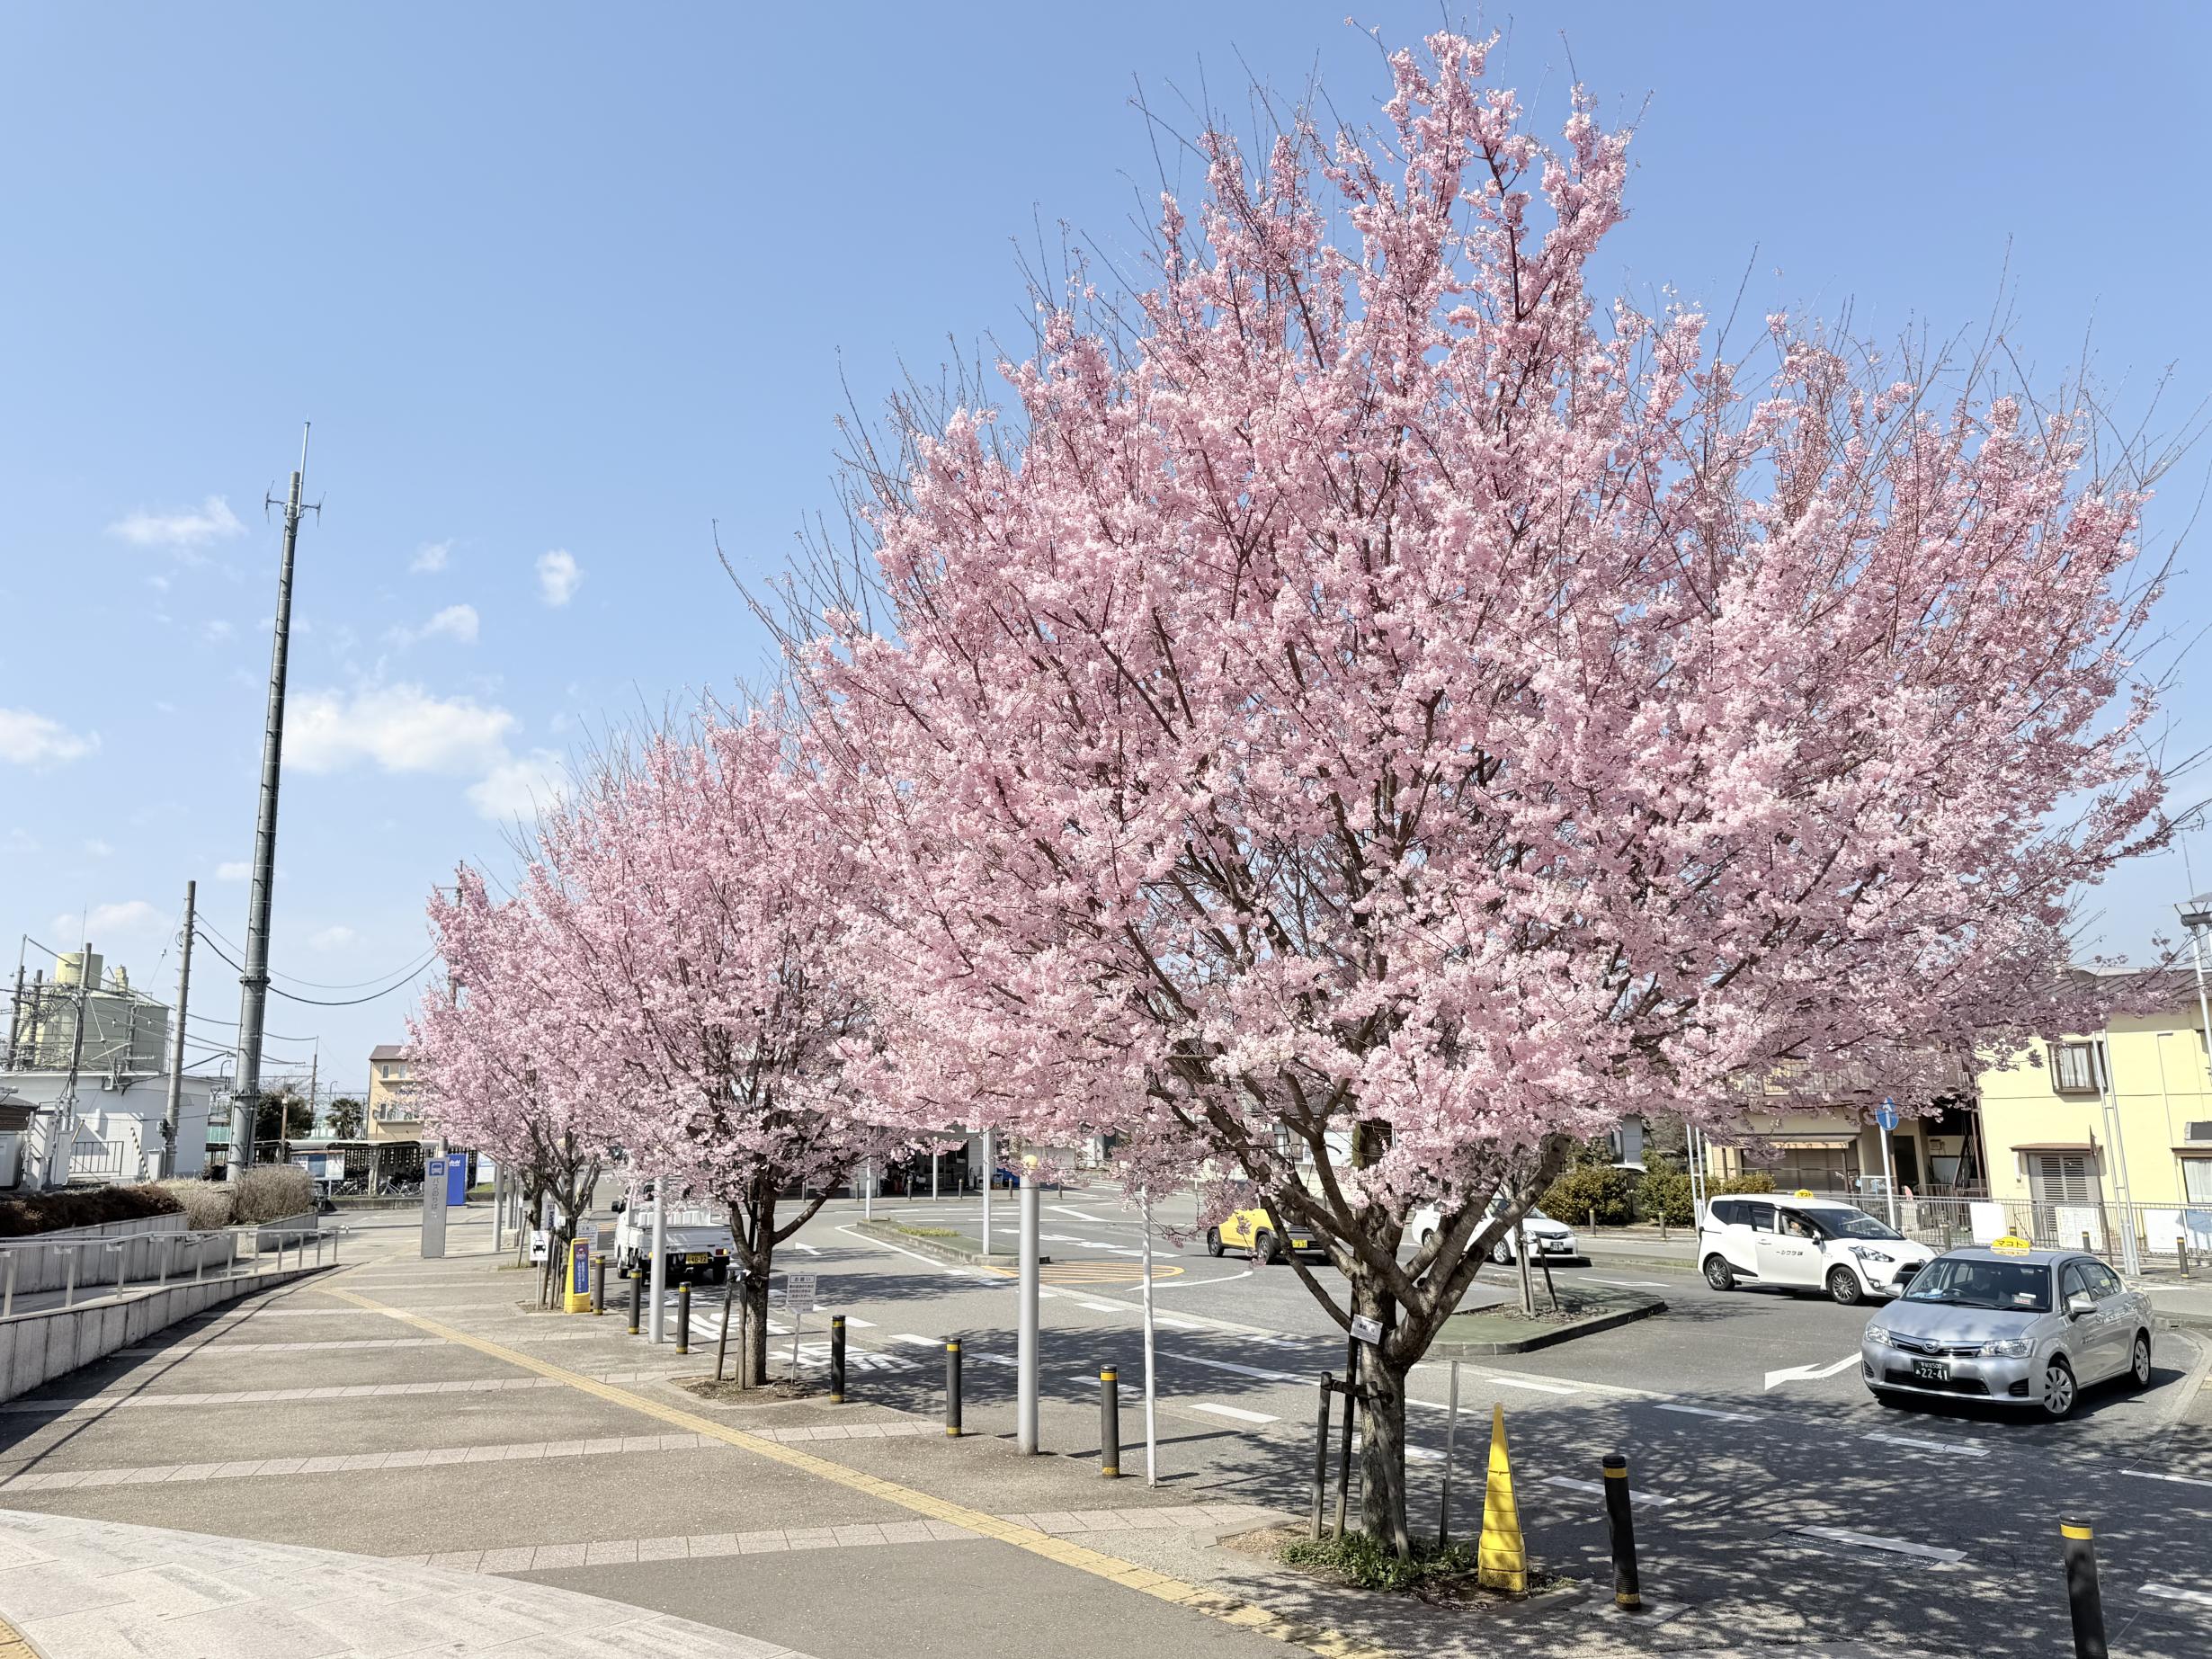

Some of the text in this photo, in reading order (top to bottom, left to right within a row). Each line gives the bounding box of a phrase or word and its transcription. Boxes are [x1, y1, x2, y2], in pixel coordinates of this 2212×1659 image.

[1997, 1240, 2023, 1248] マコト
[1921, 1368, 1948, 1381] 22-41
